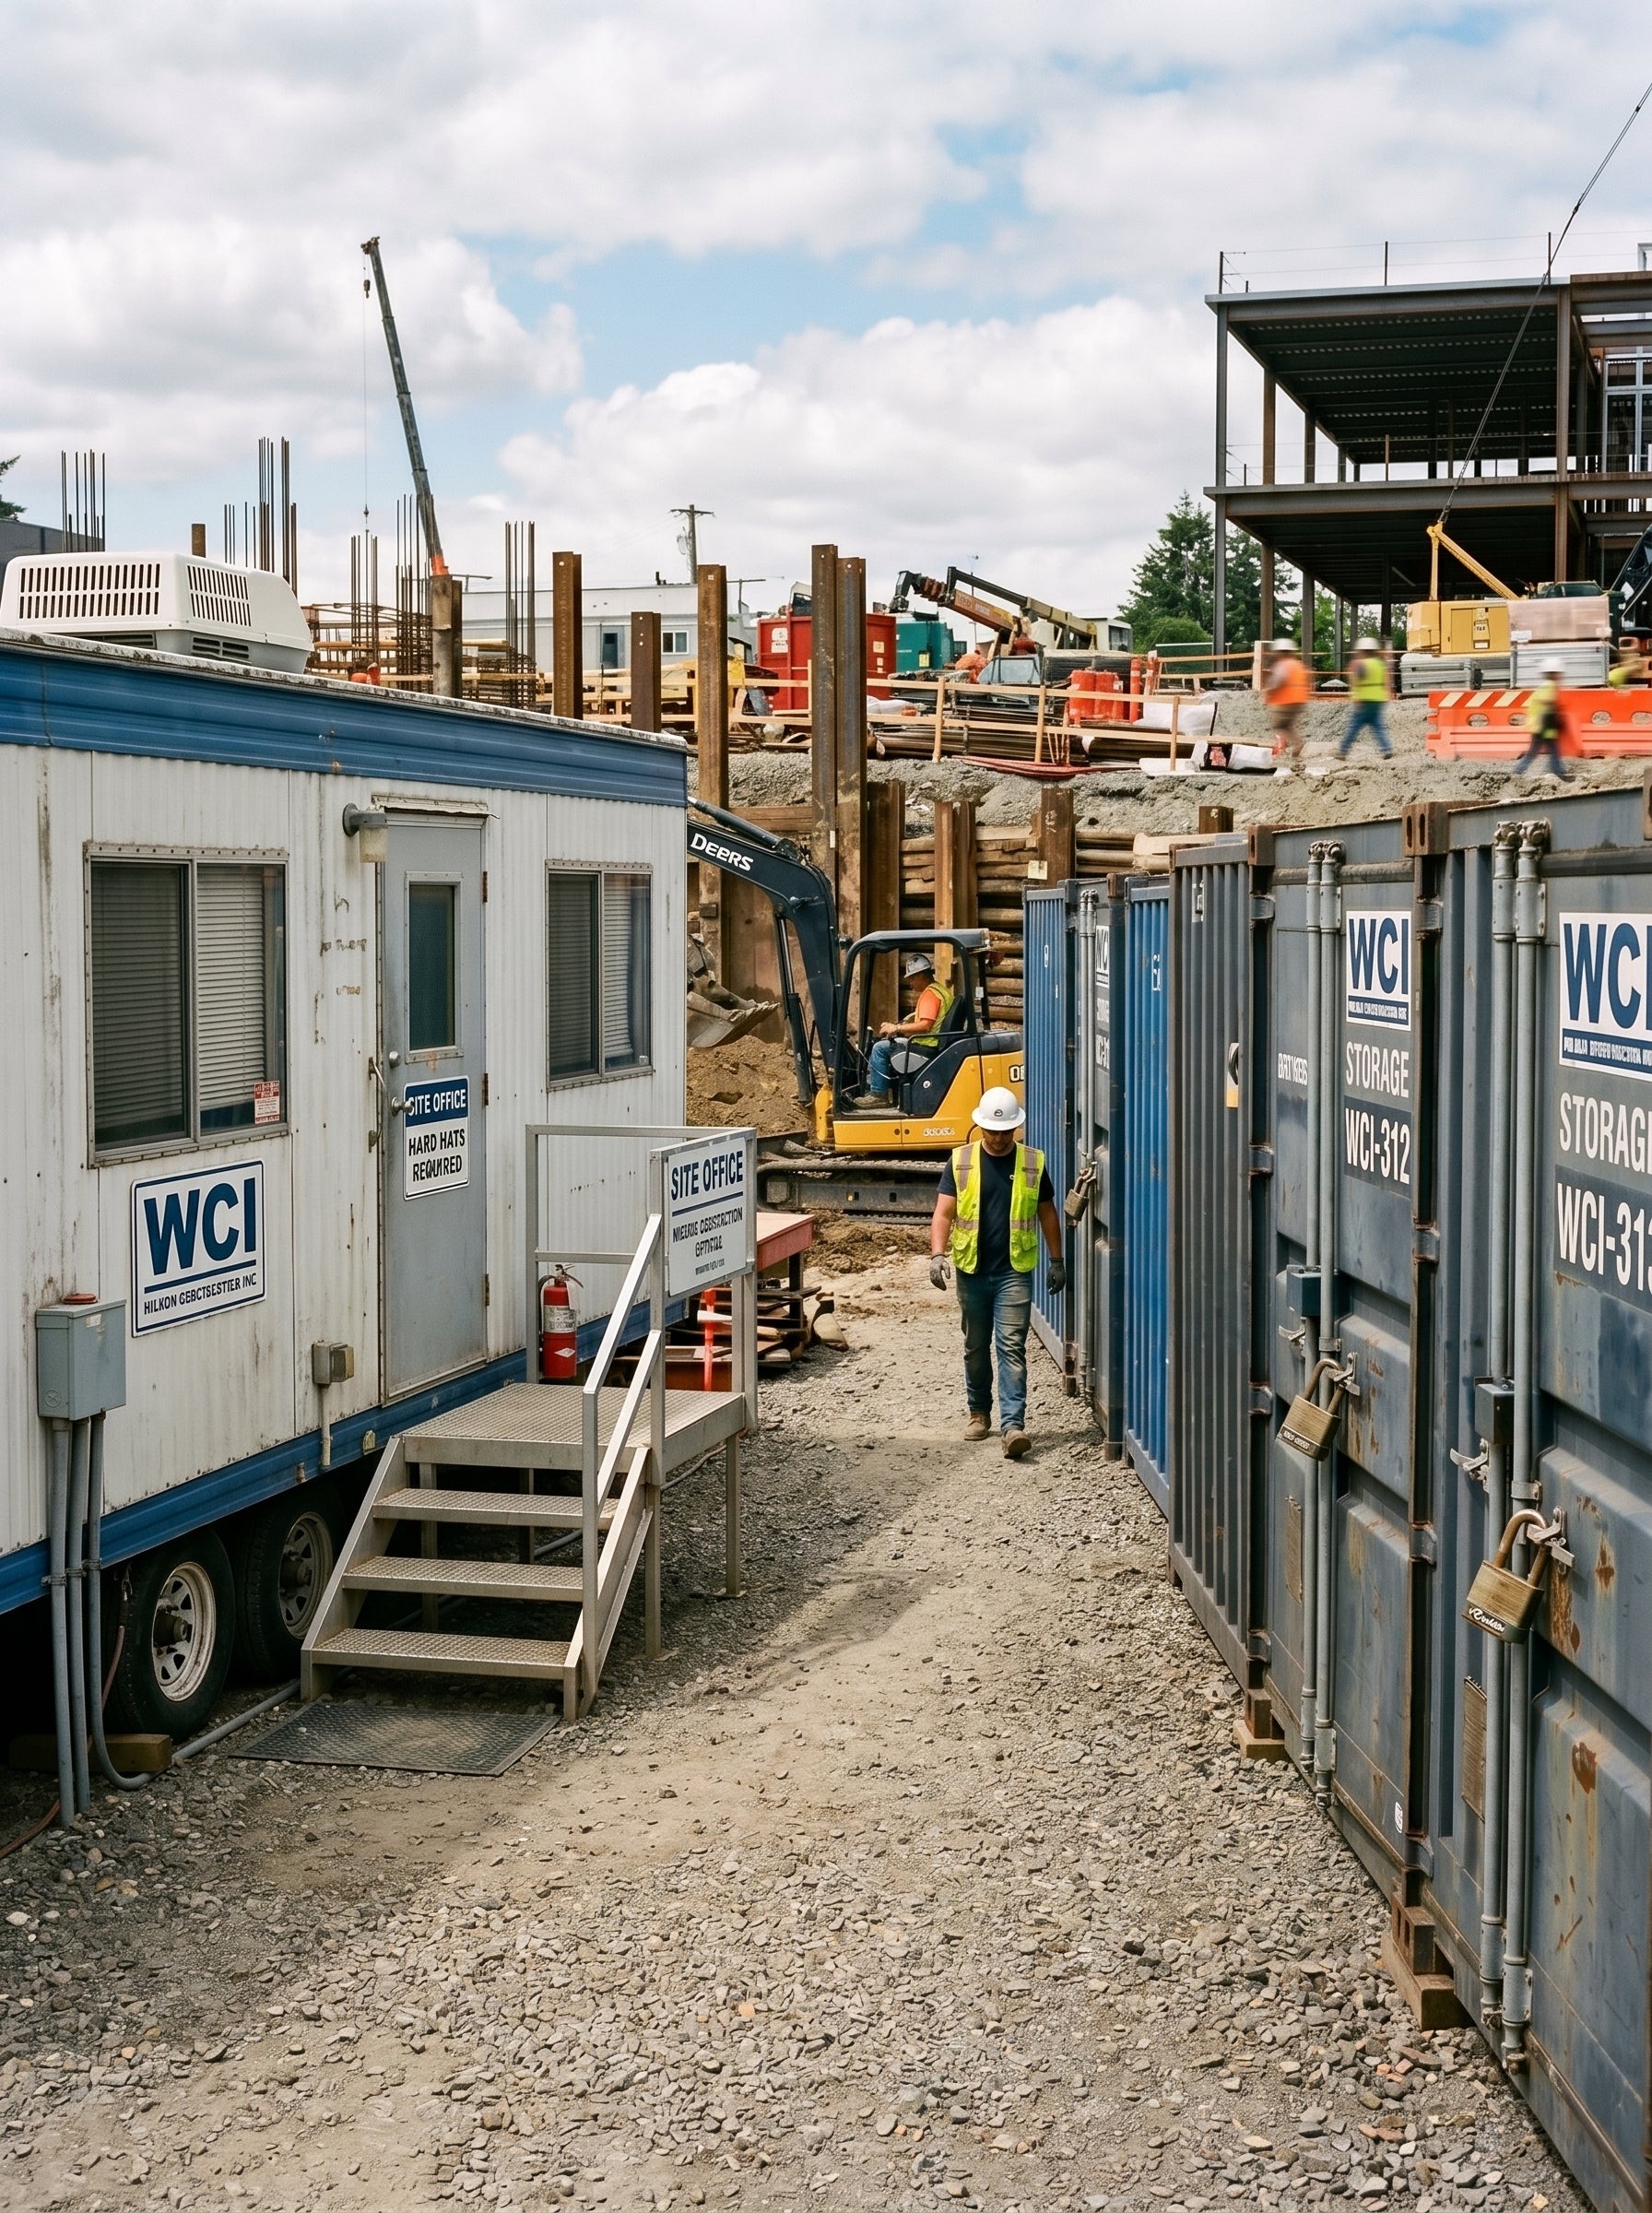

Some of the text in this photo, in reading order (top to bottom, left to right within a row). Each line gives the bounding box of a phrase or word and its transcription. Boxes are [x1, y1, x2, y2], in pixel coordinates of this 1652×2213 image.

[1348, 917, 1409, 995] WCI
[1345, 1041, 1410, 1098] STORAGE
[433, 1089, 466, 1112] OFFICE
[408, 1129, 466, 1156] HARD HATS
[1345, 1107, 1410, 1185] WCI-312
[670, 1151, 743, 1201] SITE OFFICE
[143, 1177, 257, 1276] WCI
[144, 1295, 177, 1315] HILKON
[242, 1272, 257, 1288] INC
